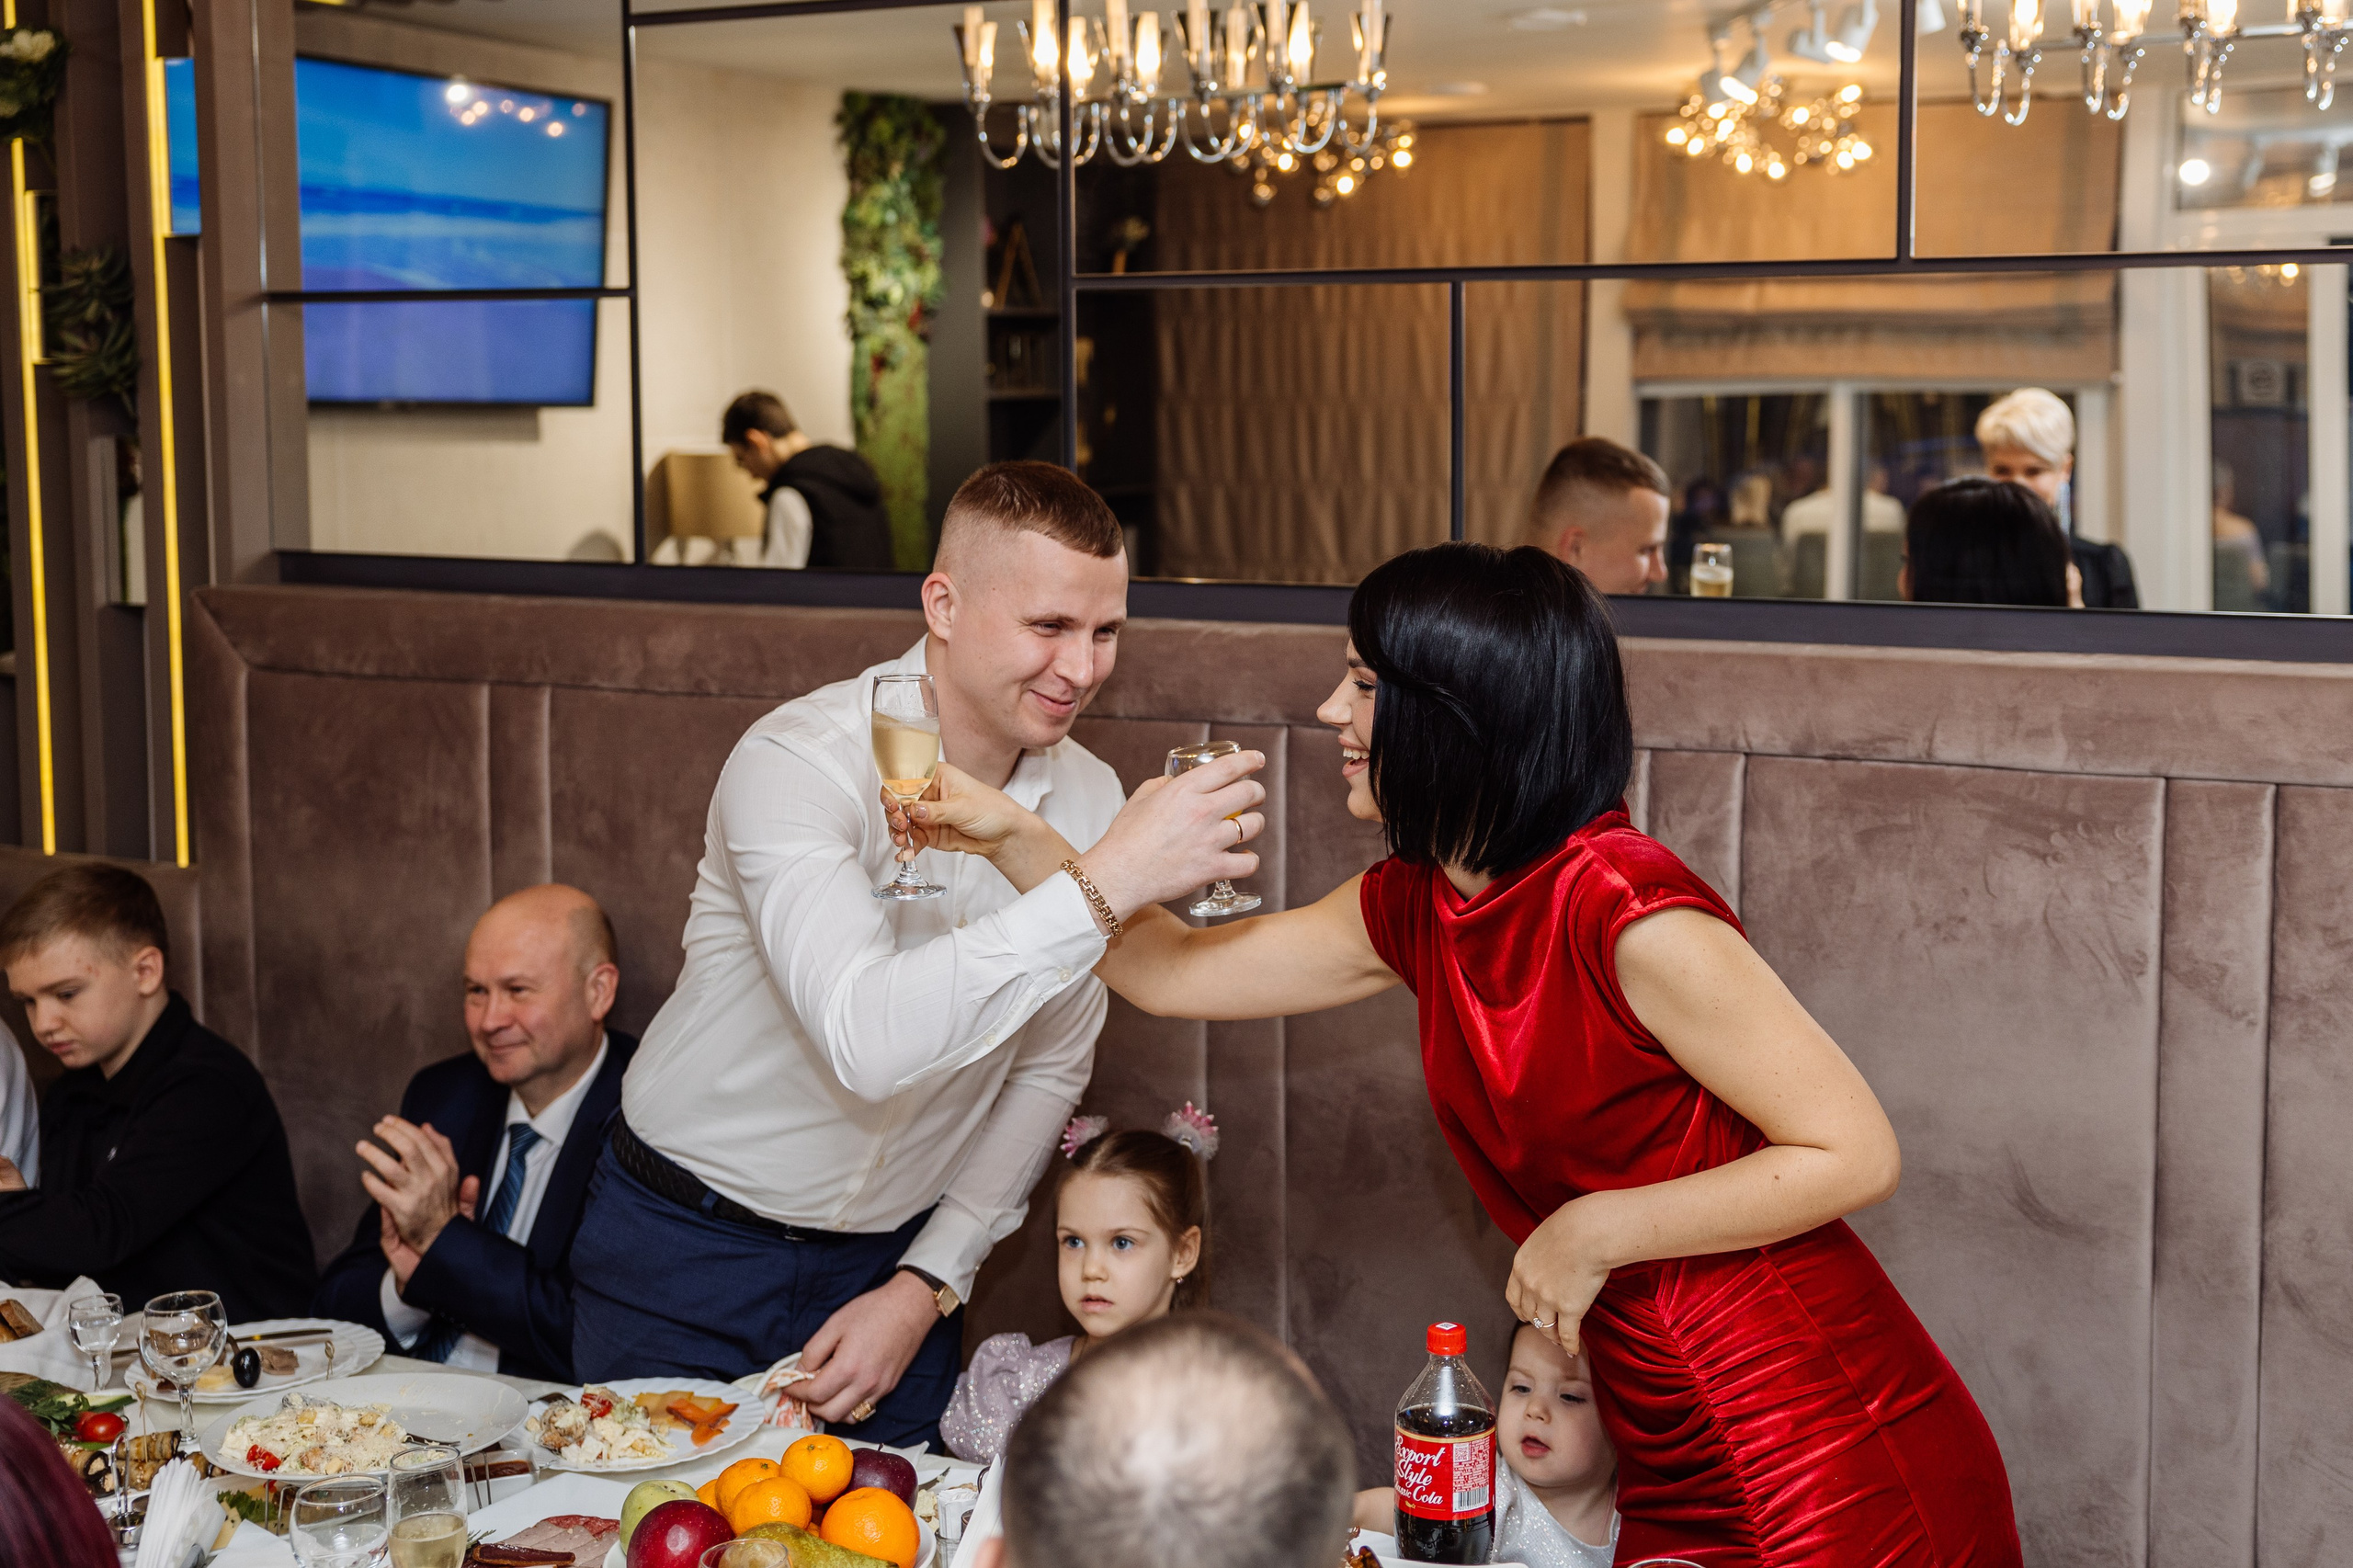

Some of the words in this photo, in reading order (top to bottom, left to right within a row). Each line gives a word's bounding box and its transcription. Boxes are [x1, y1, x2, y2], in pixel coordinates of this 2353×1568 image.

[1395, 1435, 1446, 1470] Export
[1397, 1459, 1433, 1488] Style
[1413, 1485, 1443, 1505] Cola
